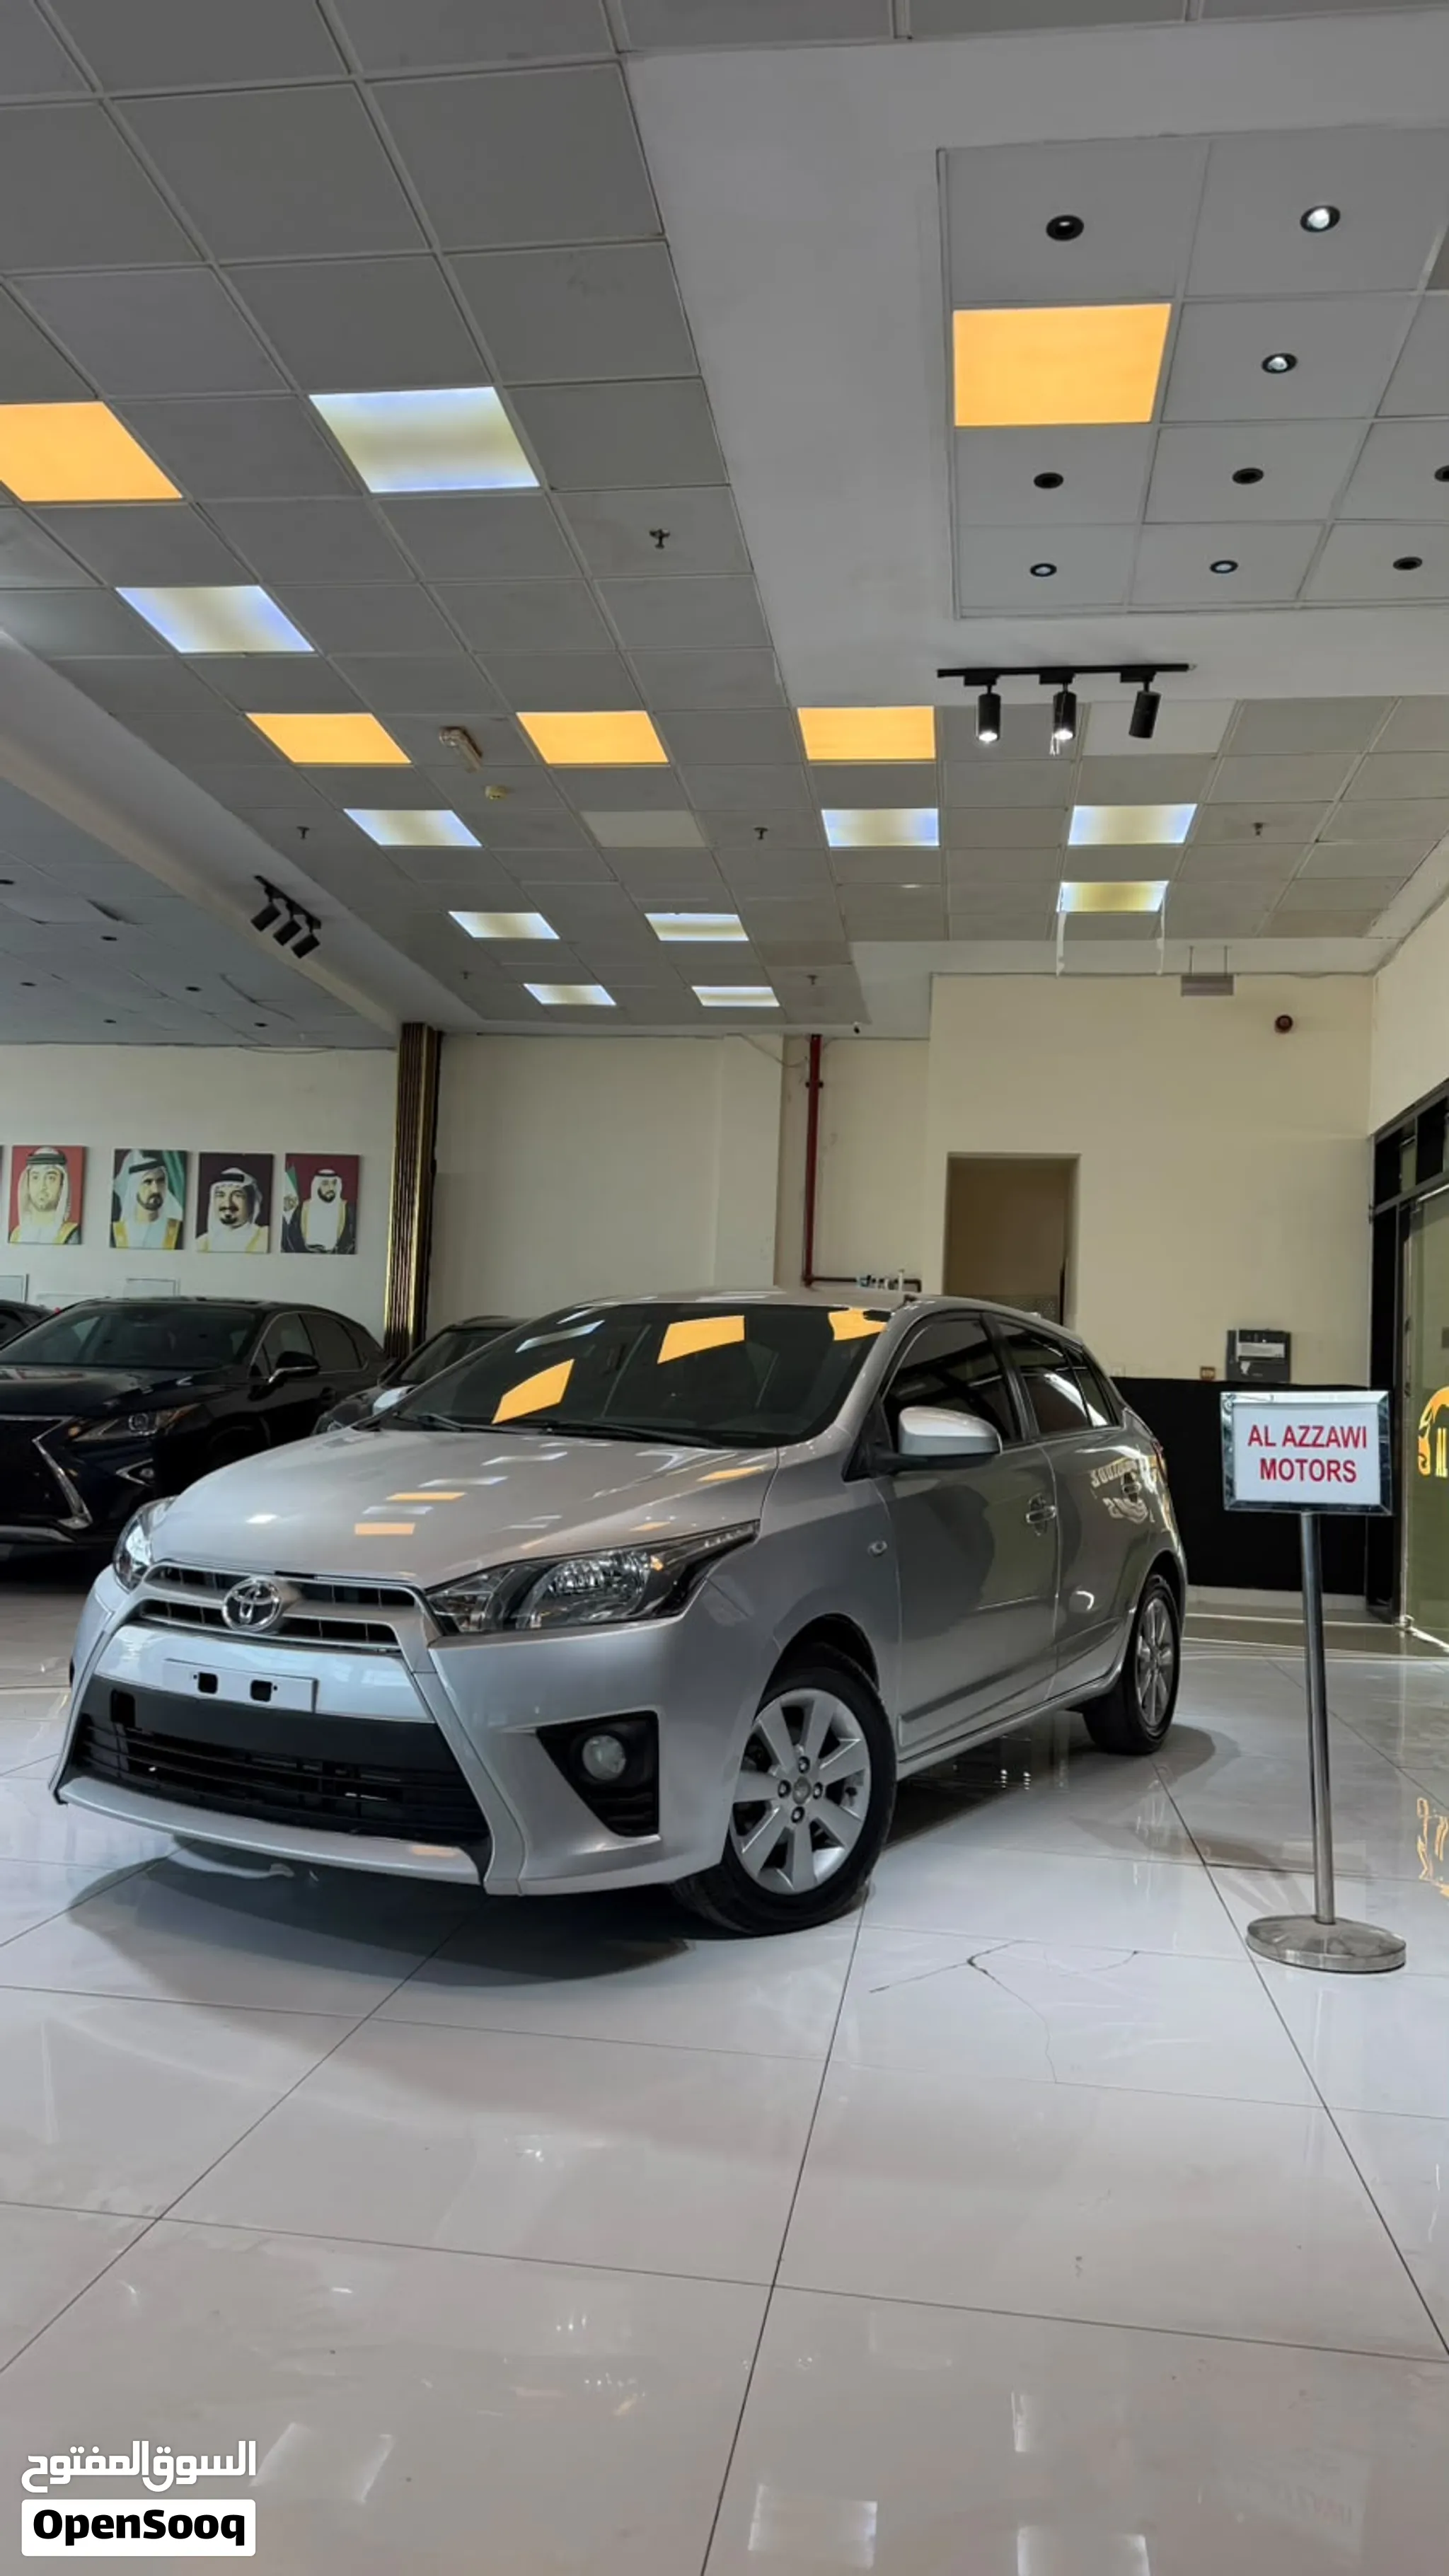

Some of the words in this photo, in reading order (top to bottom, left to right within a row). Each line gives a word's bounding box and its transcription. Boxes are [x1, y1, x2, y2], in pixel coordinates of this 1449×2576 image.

[1247, 1425, 1276, 1447] AL
[1282, 1426, 1367, 1448] AZZAWI
[1259, 1458, 1357, 1483] MOTORS
